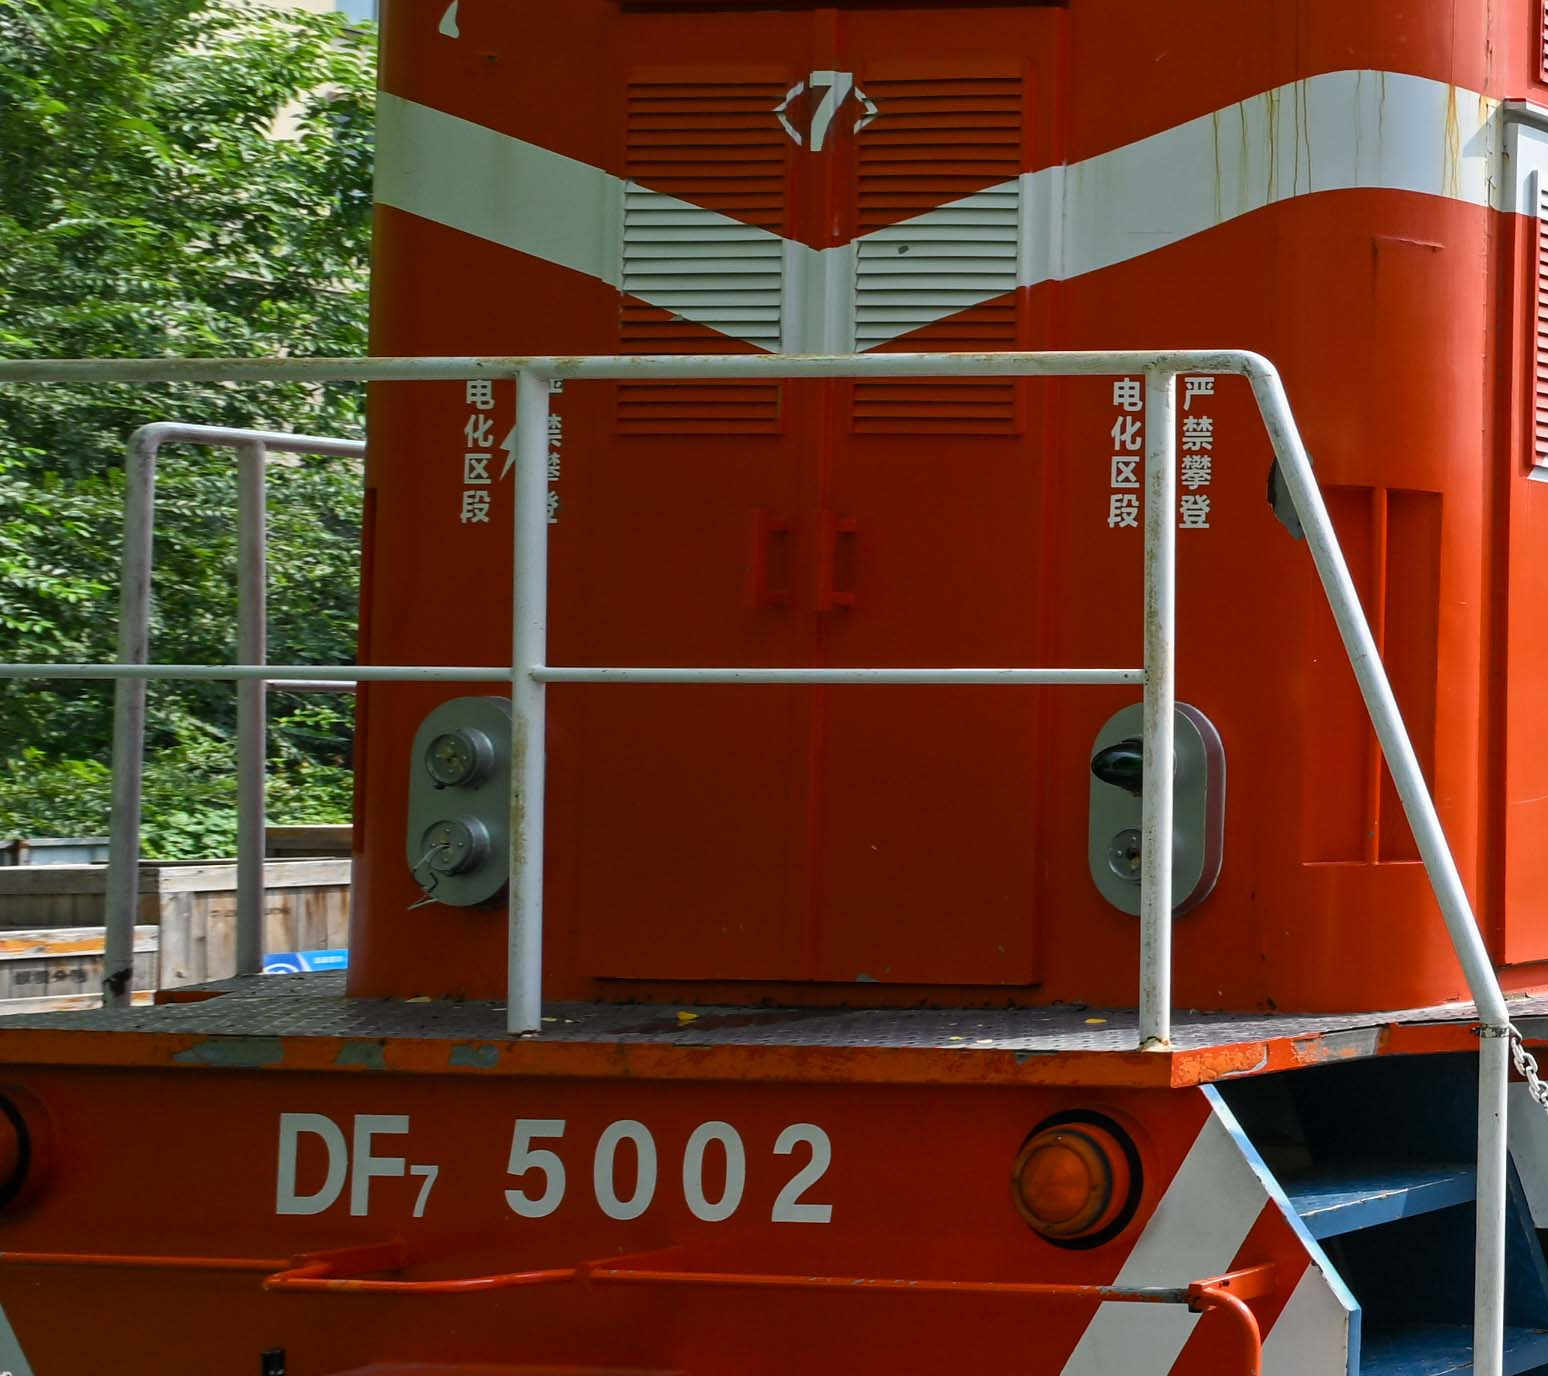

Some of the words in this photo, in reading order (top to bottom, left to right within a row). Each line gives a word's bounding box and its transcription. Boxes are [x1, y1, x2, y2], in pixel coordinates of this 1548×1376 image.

[809, 70, 853, 152] 7
[460, 379, 495, 524] 电化区段
[1107, 377, 1143, 528] 电化区段
[1179, 377, 1215, 528] 严禁攀登
[504, 1118, 832, 1223] 5002
